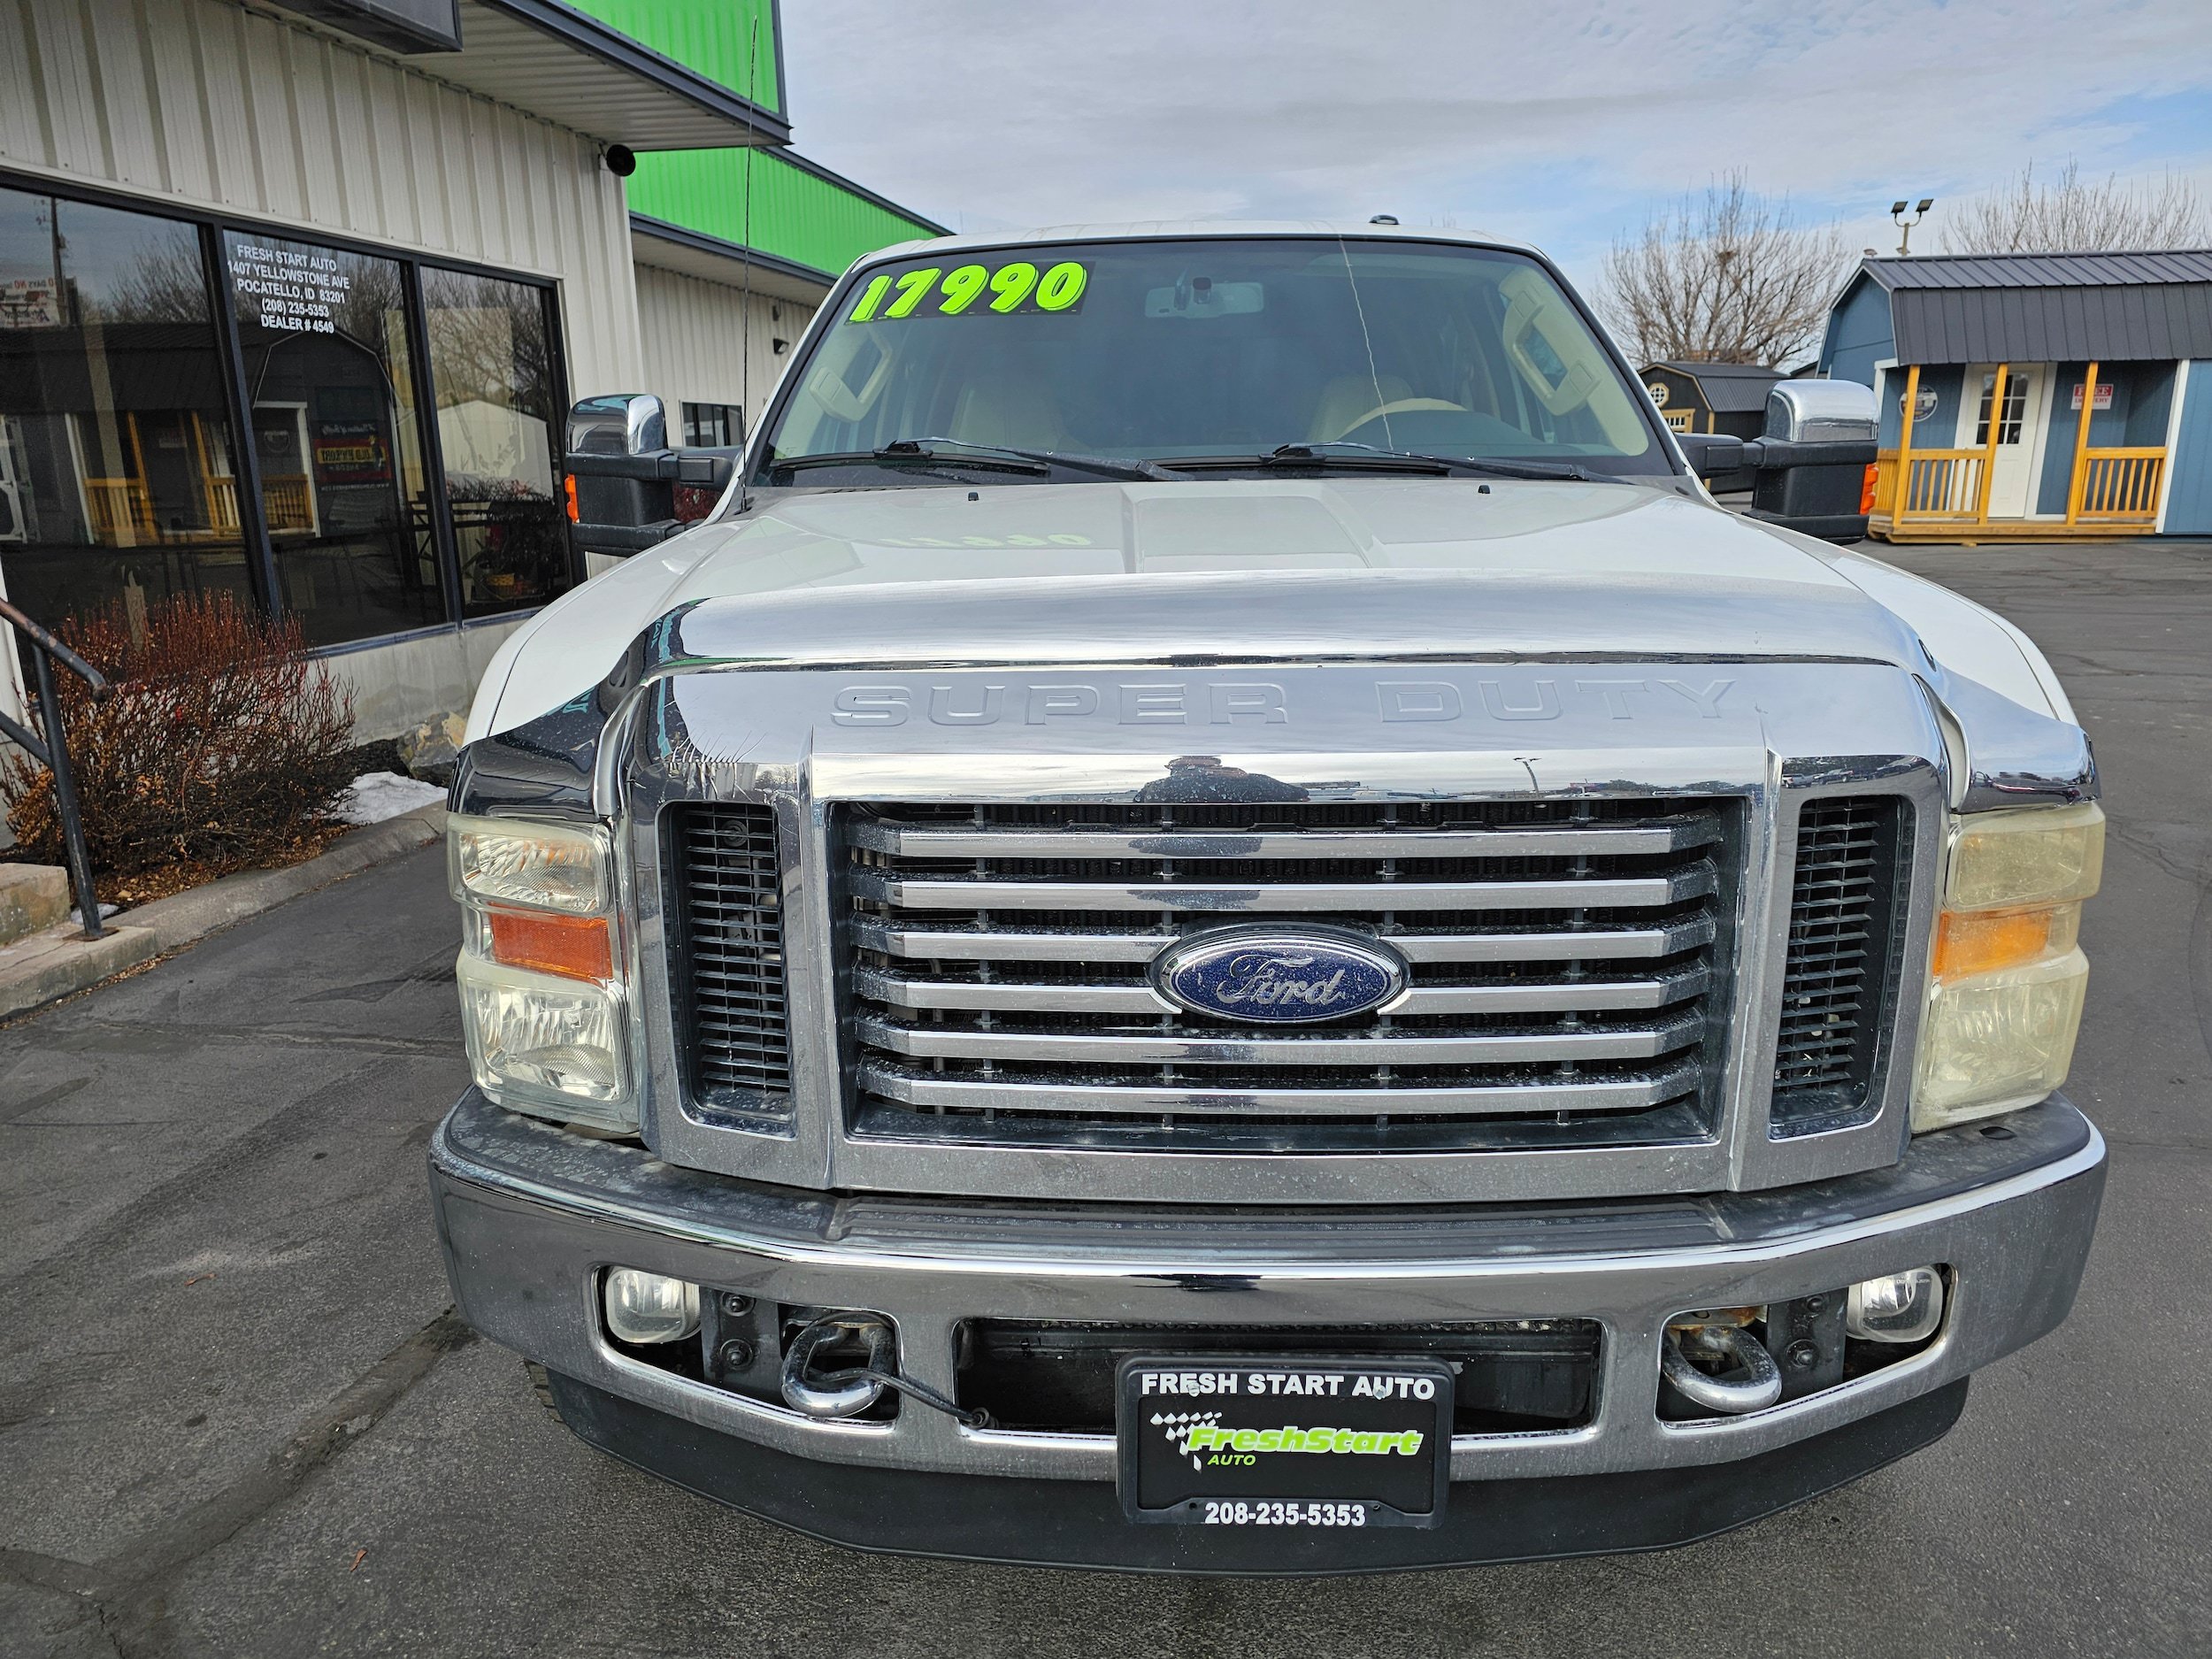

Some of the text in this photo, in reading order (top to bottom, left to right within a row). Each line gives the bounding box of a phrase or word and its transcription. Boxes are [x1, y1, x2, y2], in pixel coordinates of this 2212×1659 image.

[237, 244, 337, 272] FRESH START AUTO
[227, 260, 350, 289] 1407 YELLOWSTONE AVE
[236, 278, 345, 303] POCATELLO, ID 83201
[849, 262, 1087, 322] 17990
[261, 297, 330, 318] (208) 235-5353
[260, 314, 334, 334] DEALER # 4549
[2077, 387, 2110, 396] FEE
[830, 679, 1737, 727] SUPER DUTY
[1217, 954, 1345, 1005] Ford
[1141, 1373, 1436, 1401] FRESH START AUTO
[1187, 1425, 1424, 1455] FreshStart
[1207, 1454, 1256, 1467] AUTO
[1204, 1502, 1366, 1527] 208-235-5353
